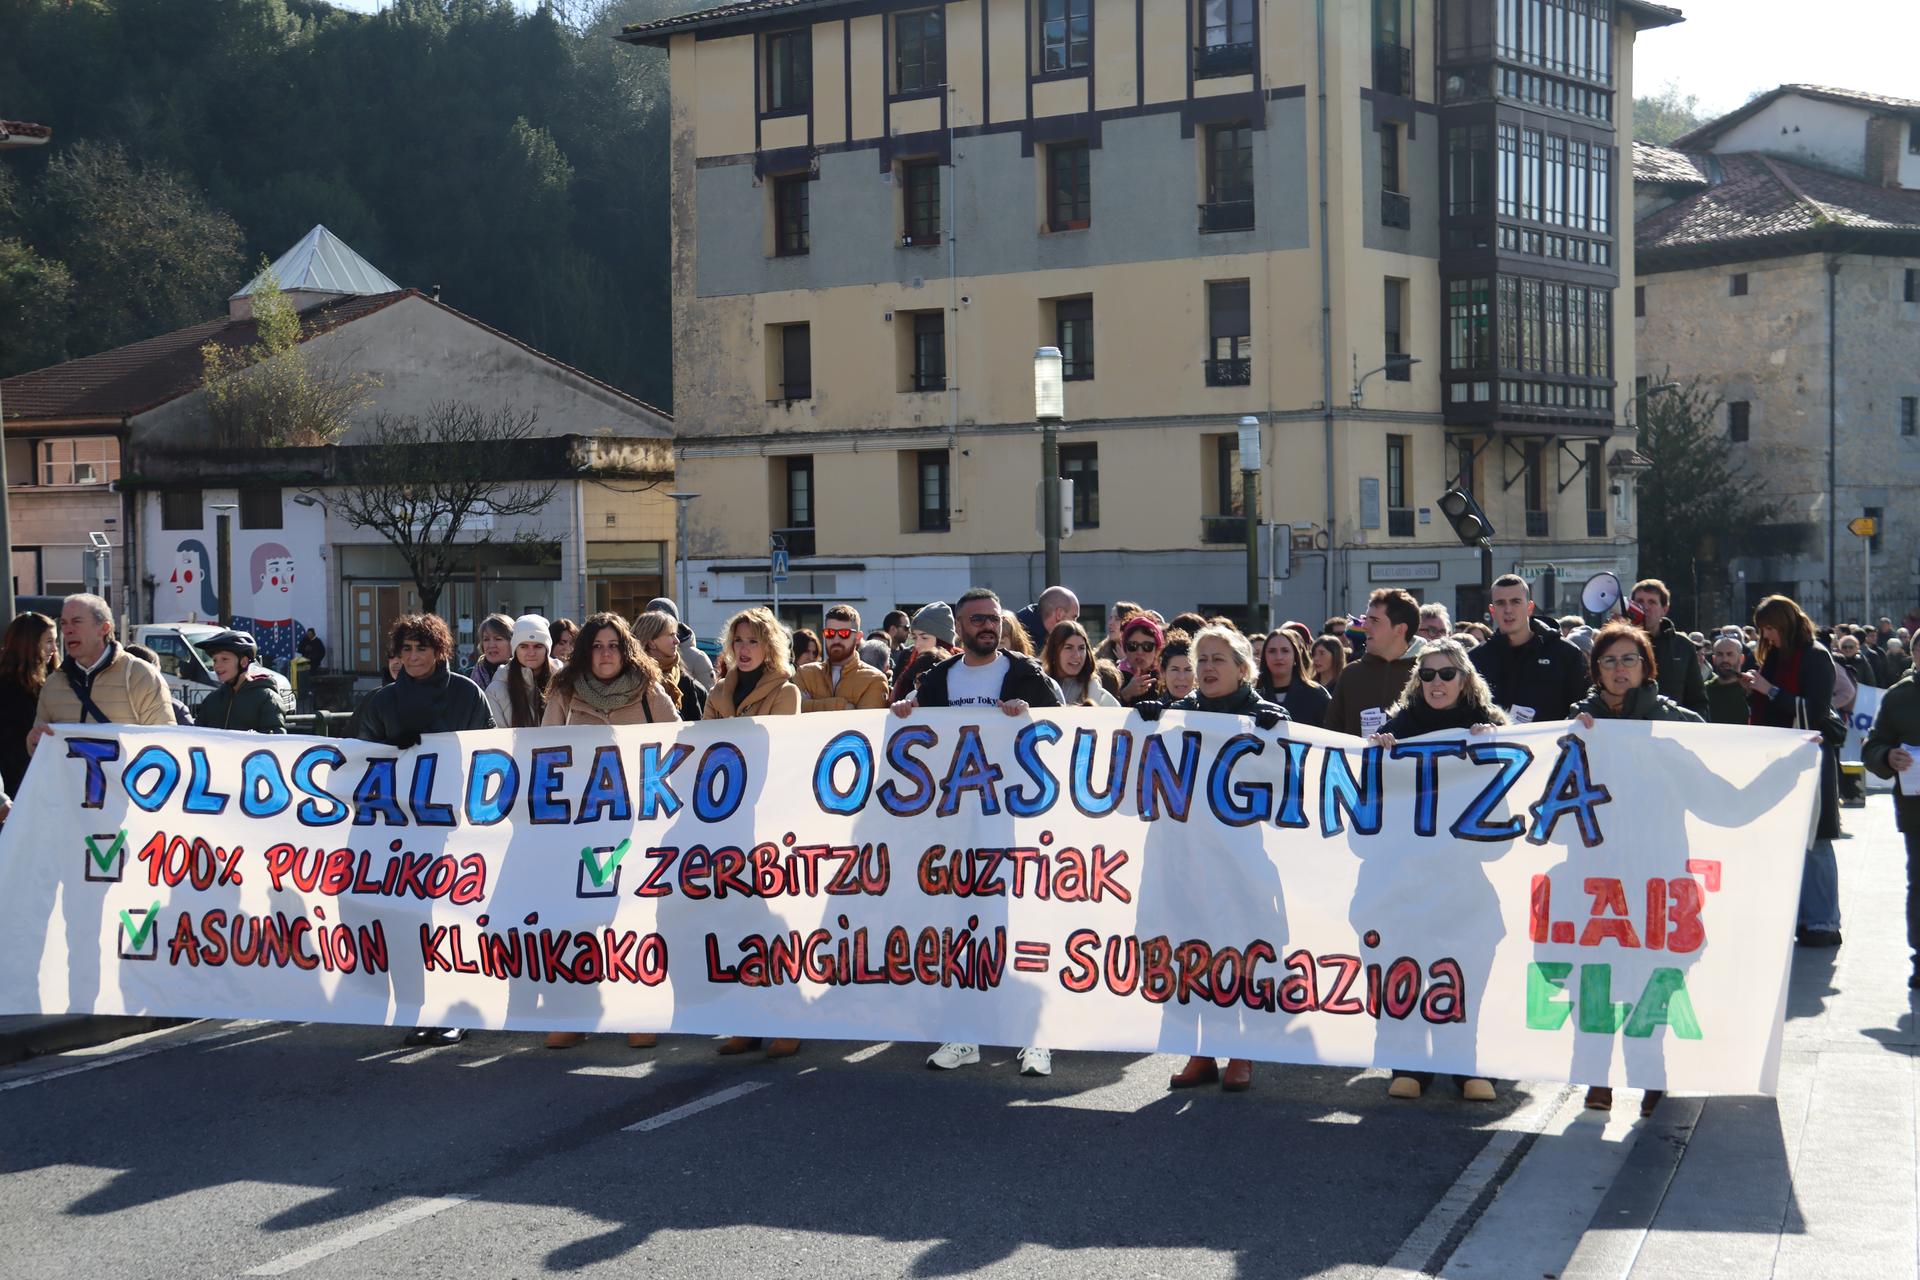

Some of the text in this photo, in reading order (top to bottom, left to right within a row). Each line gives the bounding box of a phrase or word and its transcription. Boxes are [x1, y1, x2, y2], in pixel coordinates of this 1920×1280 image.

[977, 695, 998, 707] Toky
[65, 719, 1612, 848] TOLOSALDEAKO OSASUNGINTZA
[138, 831, 243, 890] 100%
[1529, 874, 1705, 953] LAB
[1526, 961, 1703, 1040] ELA
